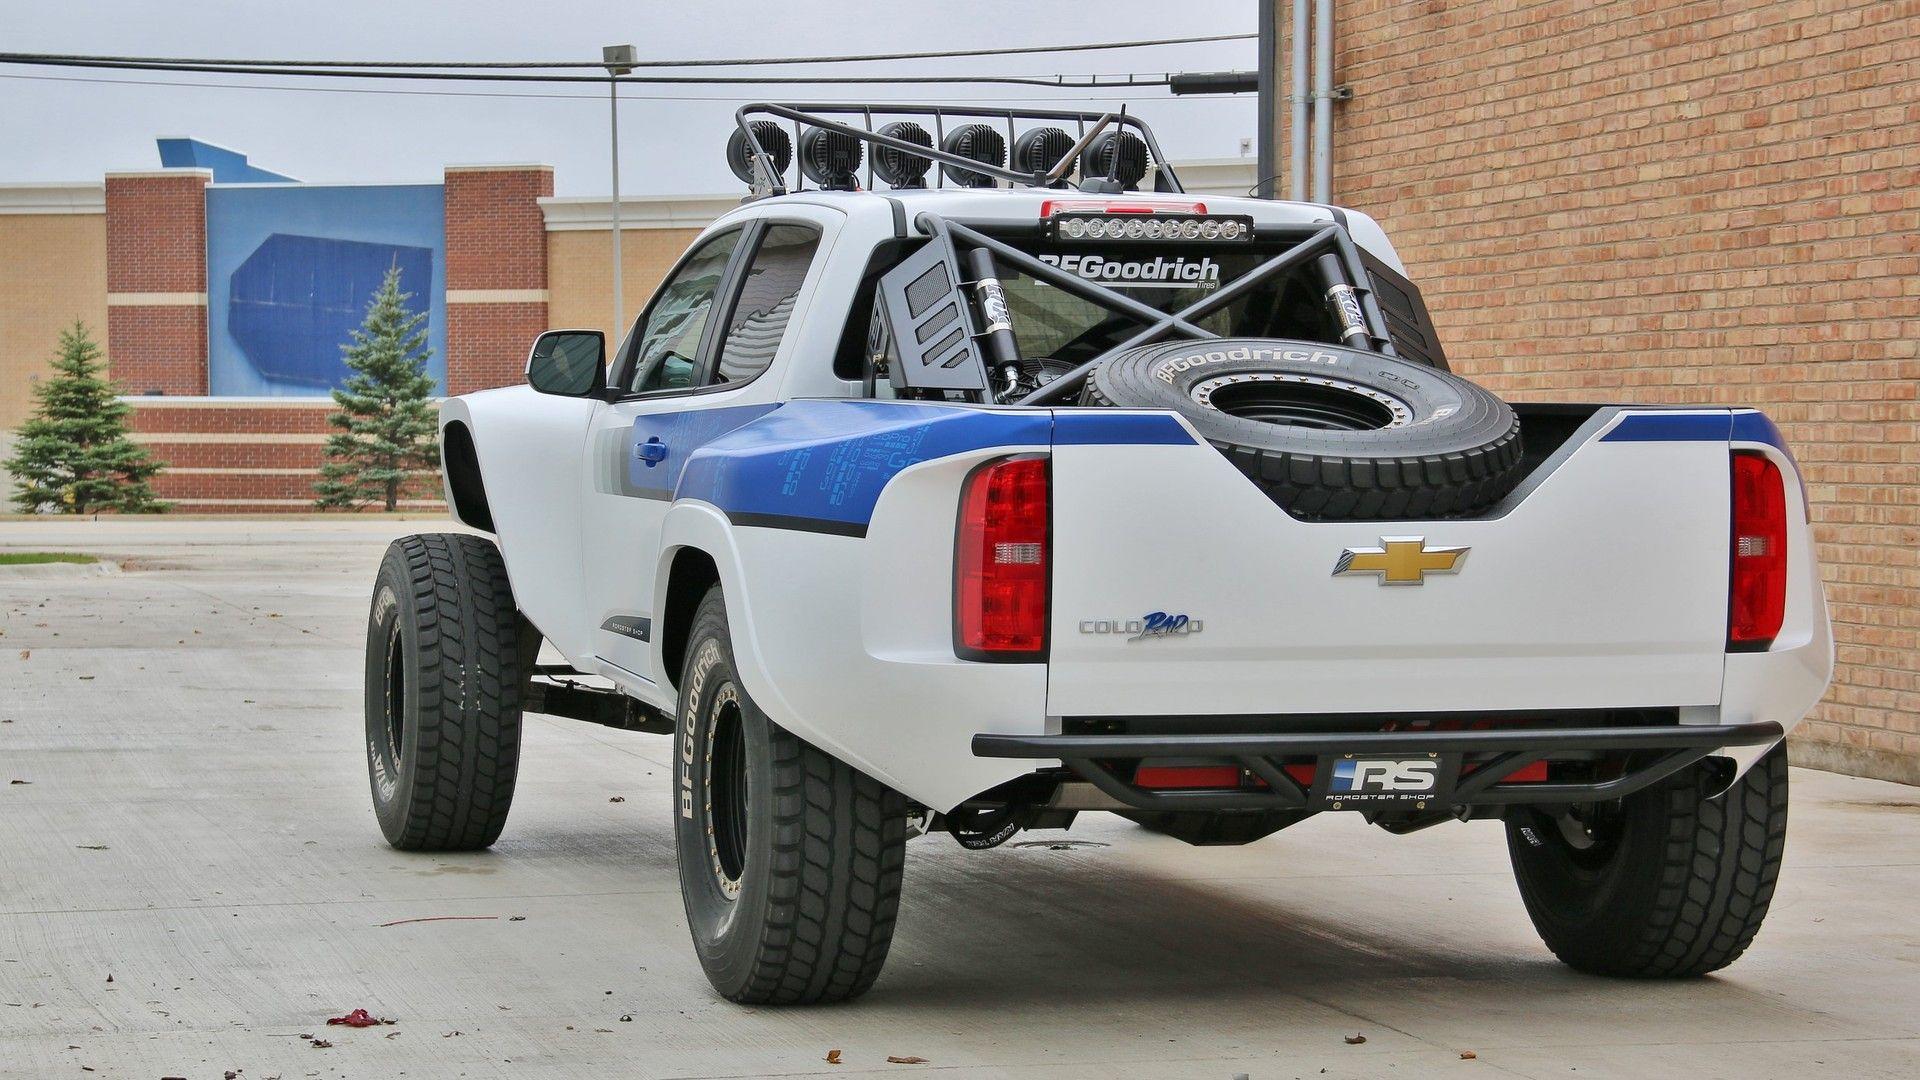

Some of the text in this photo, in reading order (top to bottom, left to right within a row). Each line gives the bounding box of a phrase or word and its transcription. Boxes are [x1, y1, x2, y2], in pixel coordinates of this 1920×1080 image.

[1197, 281, 1216, 289] Tires
[1337, 289, 1365, 328] FOX
[1156, 347, 1338, 385] BFGoodrich
[681, 637, 723, 820] BFGoodrich
[1350, 760, 1438, 791] RS
